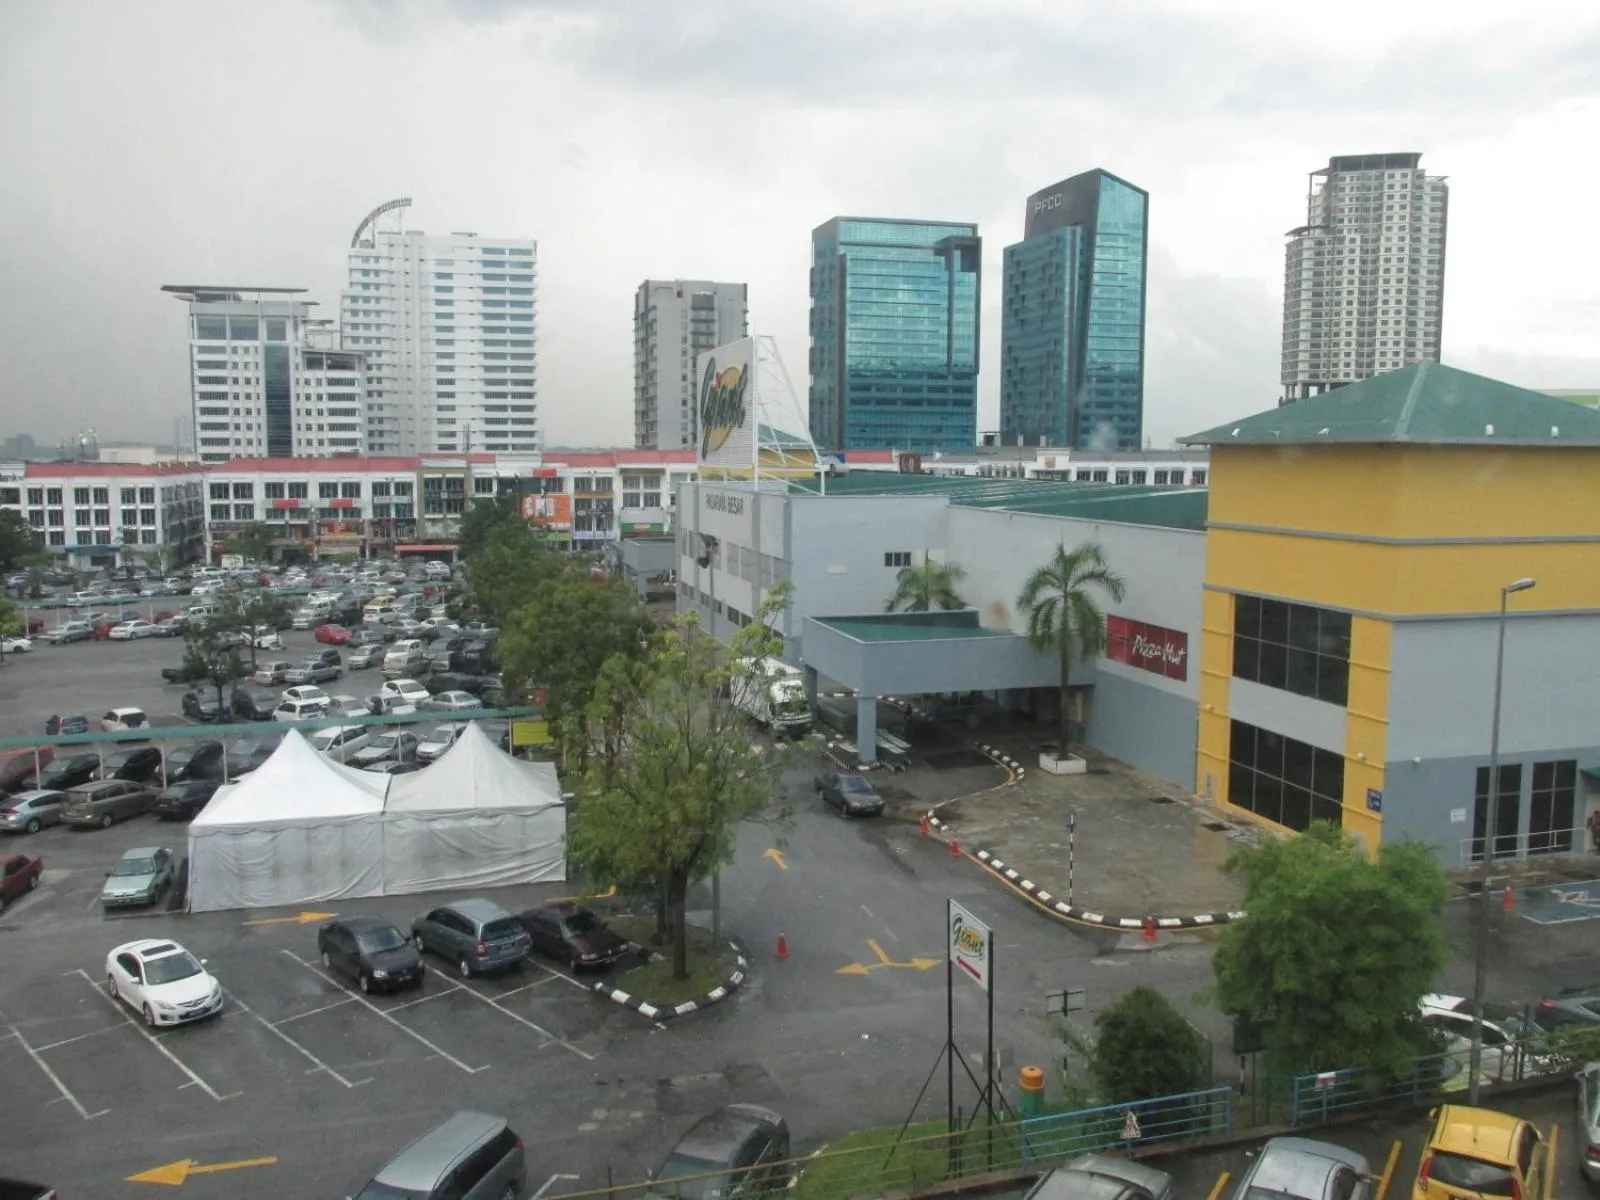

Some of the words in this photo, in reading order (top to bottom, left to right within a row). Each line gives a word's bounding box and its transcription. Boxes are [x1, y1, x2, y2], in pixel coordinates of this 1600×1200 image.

[1034, 192, 1063, 214] PFCC
[1132, 634, 1161, 658] Pizza
[1162, 641, 1186, 665] Hut
[952, 914, 985, 958] Giant
